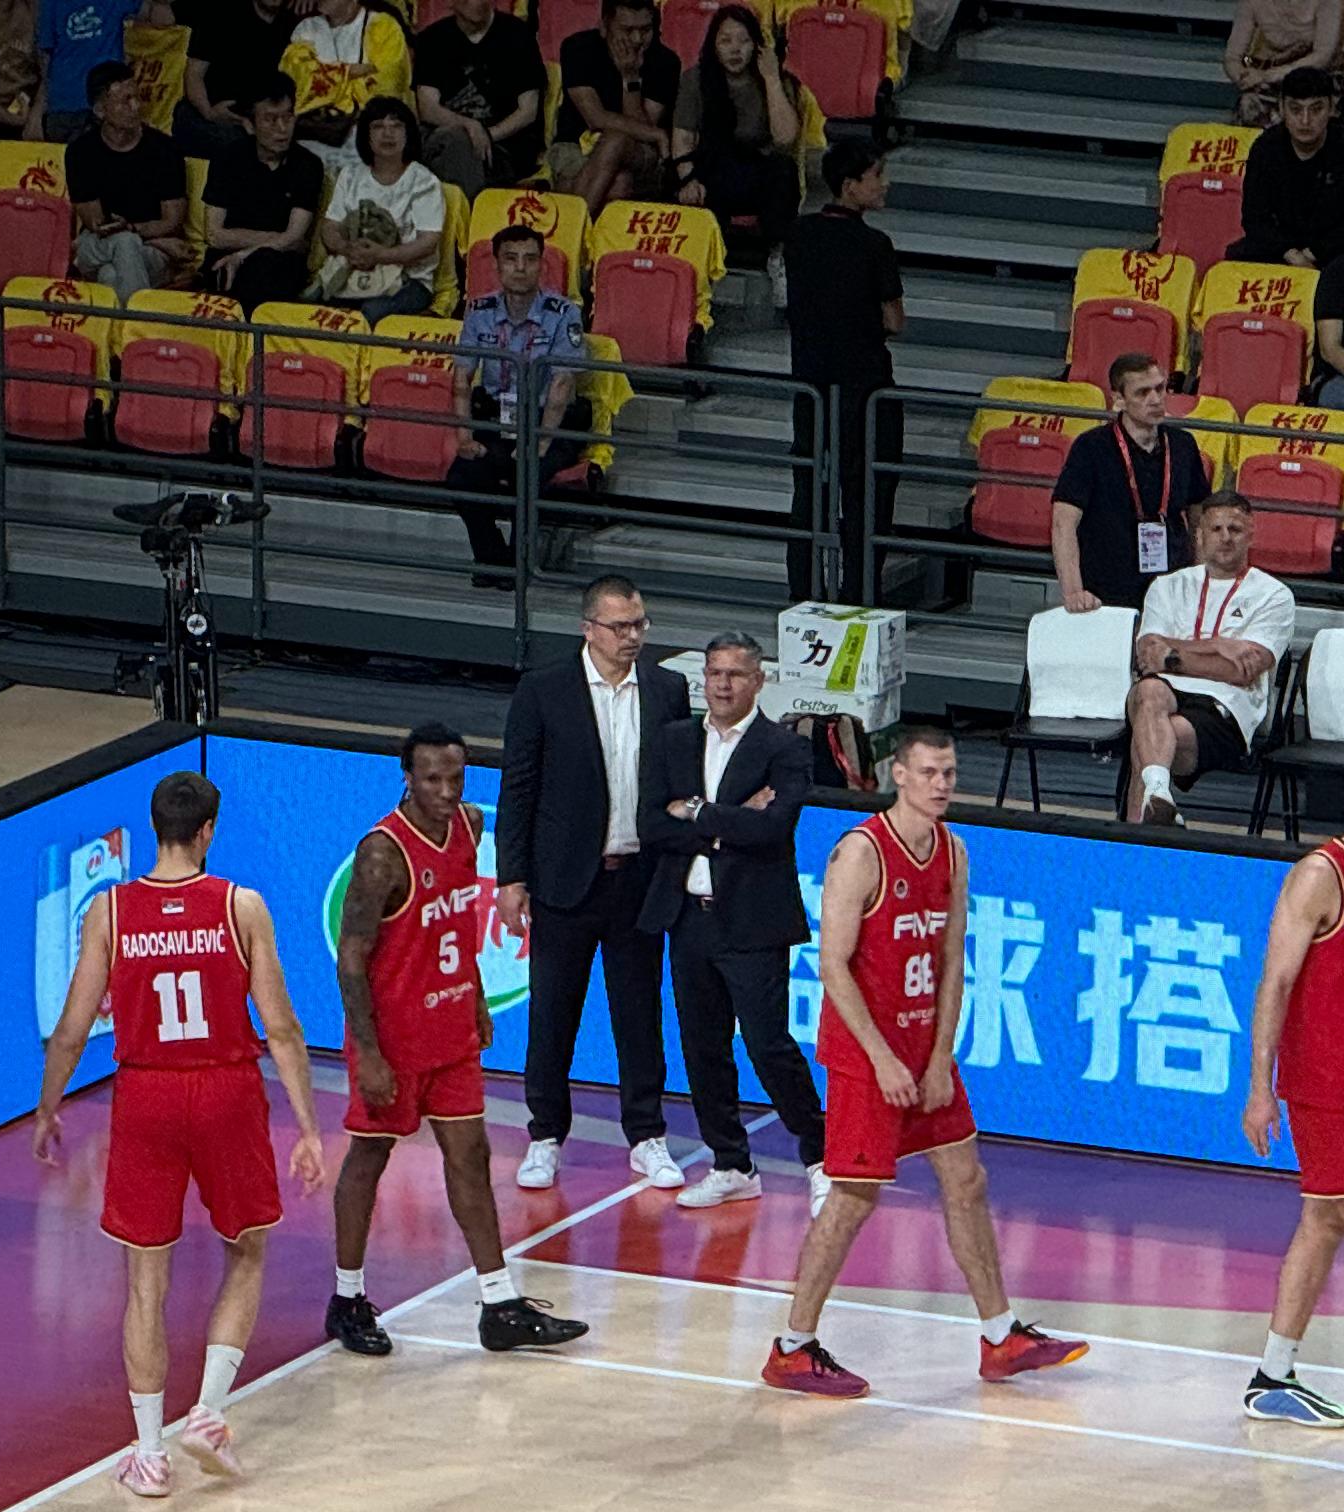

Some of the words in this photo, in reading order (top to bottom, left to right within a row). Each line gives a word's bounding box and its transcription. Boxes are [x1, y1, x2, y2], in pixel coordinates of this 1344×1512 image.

[121, 922, 226, 959] RADOSAVLJEVIĆ
[439, 931, 460, 975] 5
[152, 970, 209, 1043] 11
